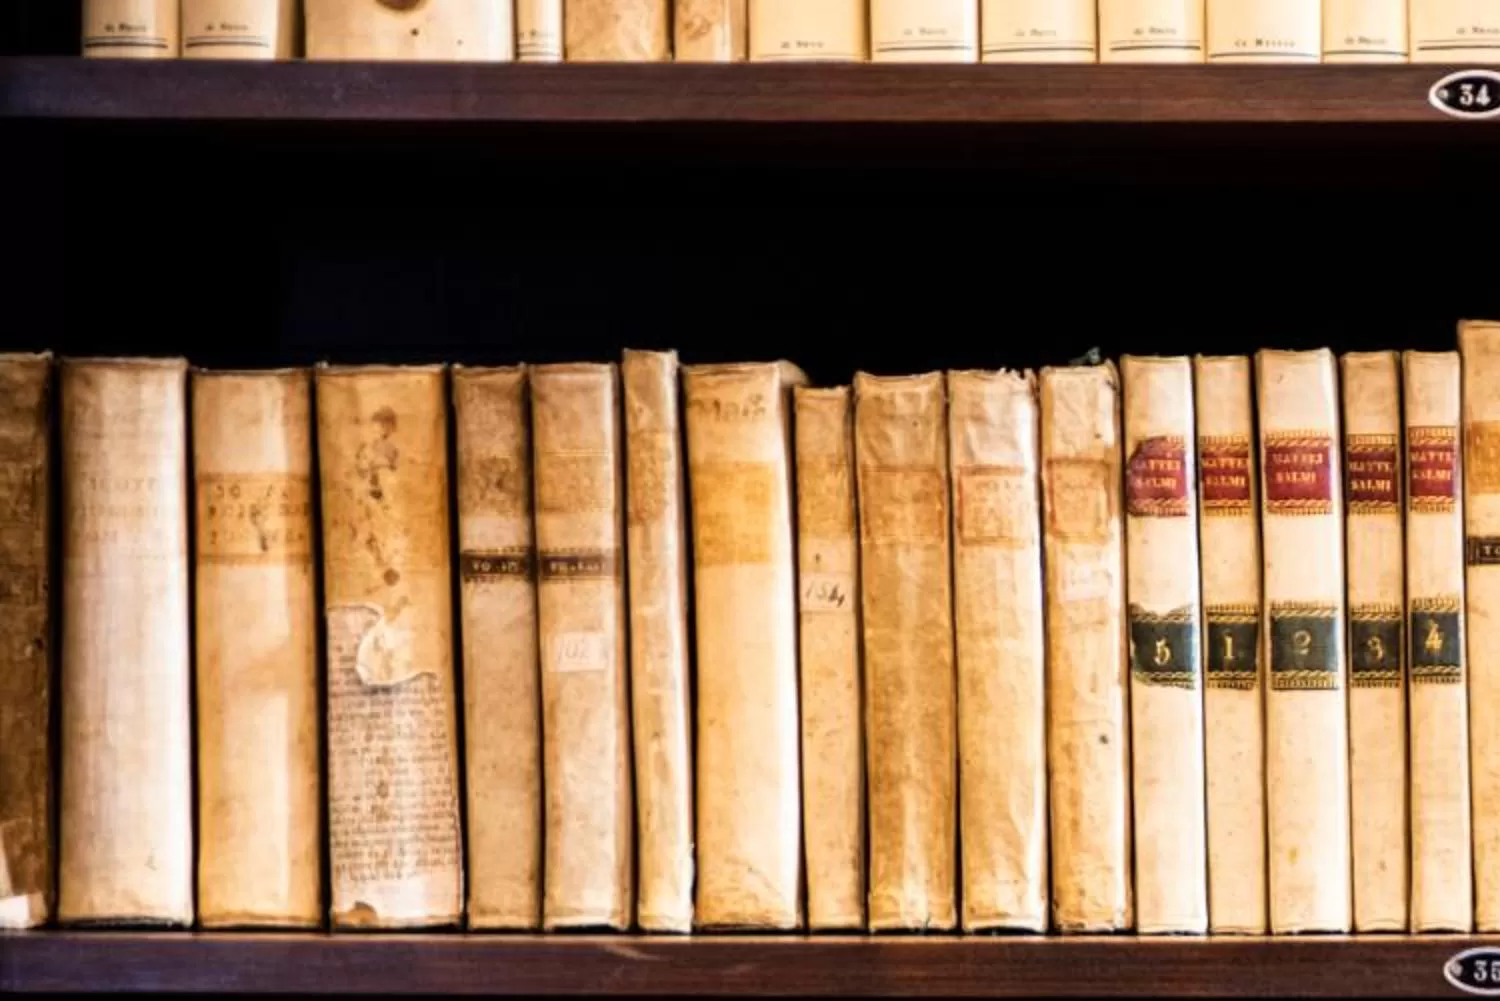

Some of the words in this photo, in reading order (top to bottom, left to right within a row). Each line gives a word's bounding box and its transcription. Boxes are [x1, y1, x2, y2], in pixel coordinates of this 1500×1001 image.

[1459, 83, 1491, 105] 34
[1222, 631, 1234, 660] 1
[1293, 630, 1310, 654] 2
[1424, 621, 1443, 650] 4
[1154, 638, 1170, 664] 5
[1367, 637, 1384, 660] 3
